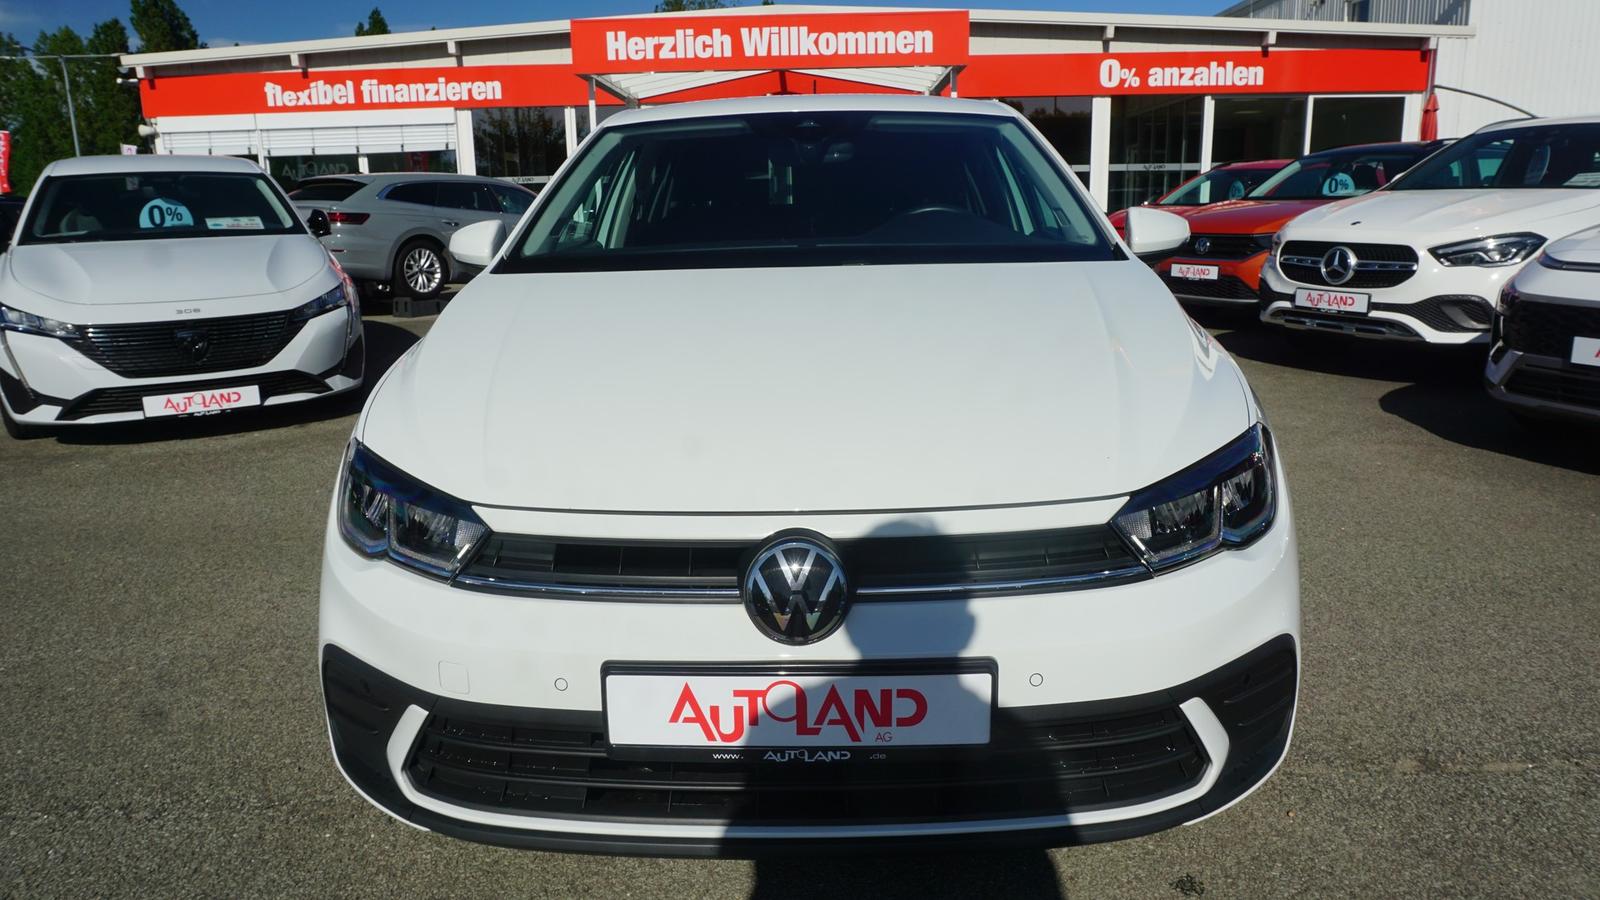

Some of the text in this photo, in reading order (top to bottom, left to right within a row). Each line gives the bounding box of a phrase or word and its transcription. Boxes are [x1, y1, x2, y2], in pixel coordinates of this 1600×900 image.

[605, 26, 934, 61] Herzlich Willkommen
[1099, 58, 1264, 88] 0% anzahlen
[264, 77, 502, 107] flexibel finanzieren
[1328, 177, 1349, 193] 0%
[148, 204, 183, 228] 0%
[875, 732, 892, 743] AG
[869, 752, 887, 760] .de
